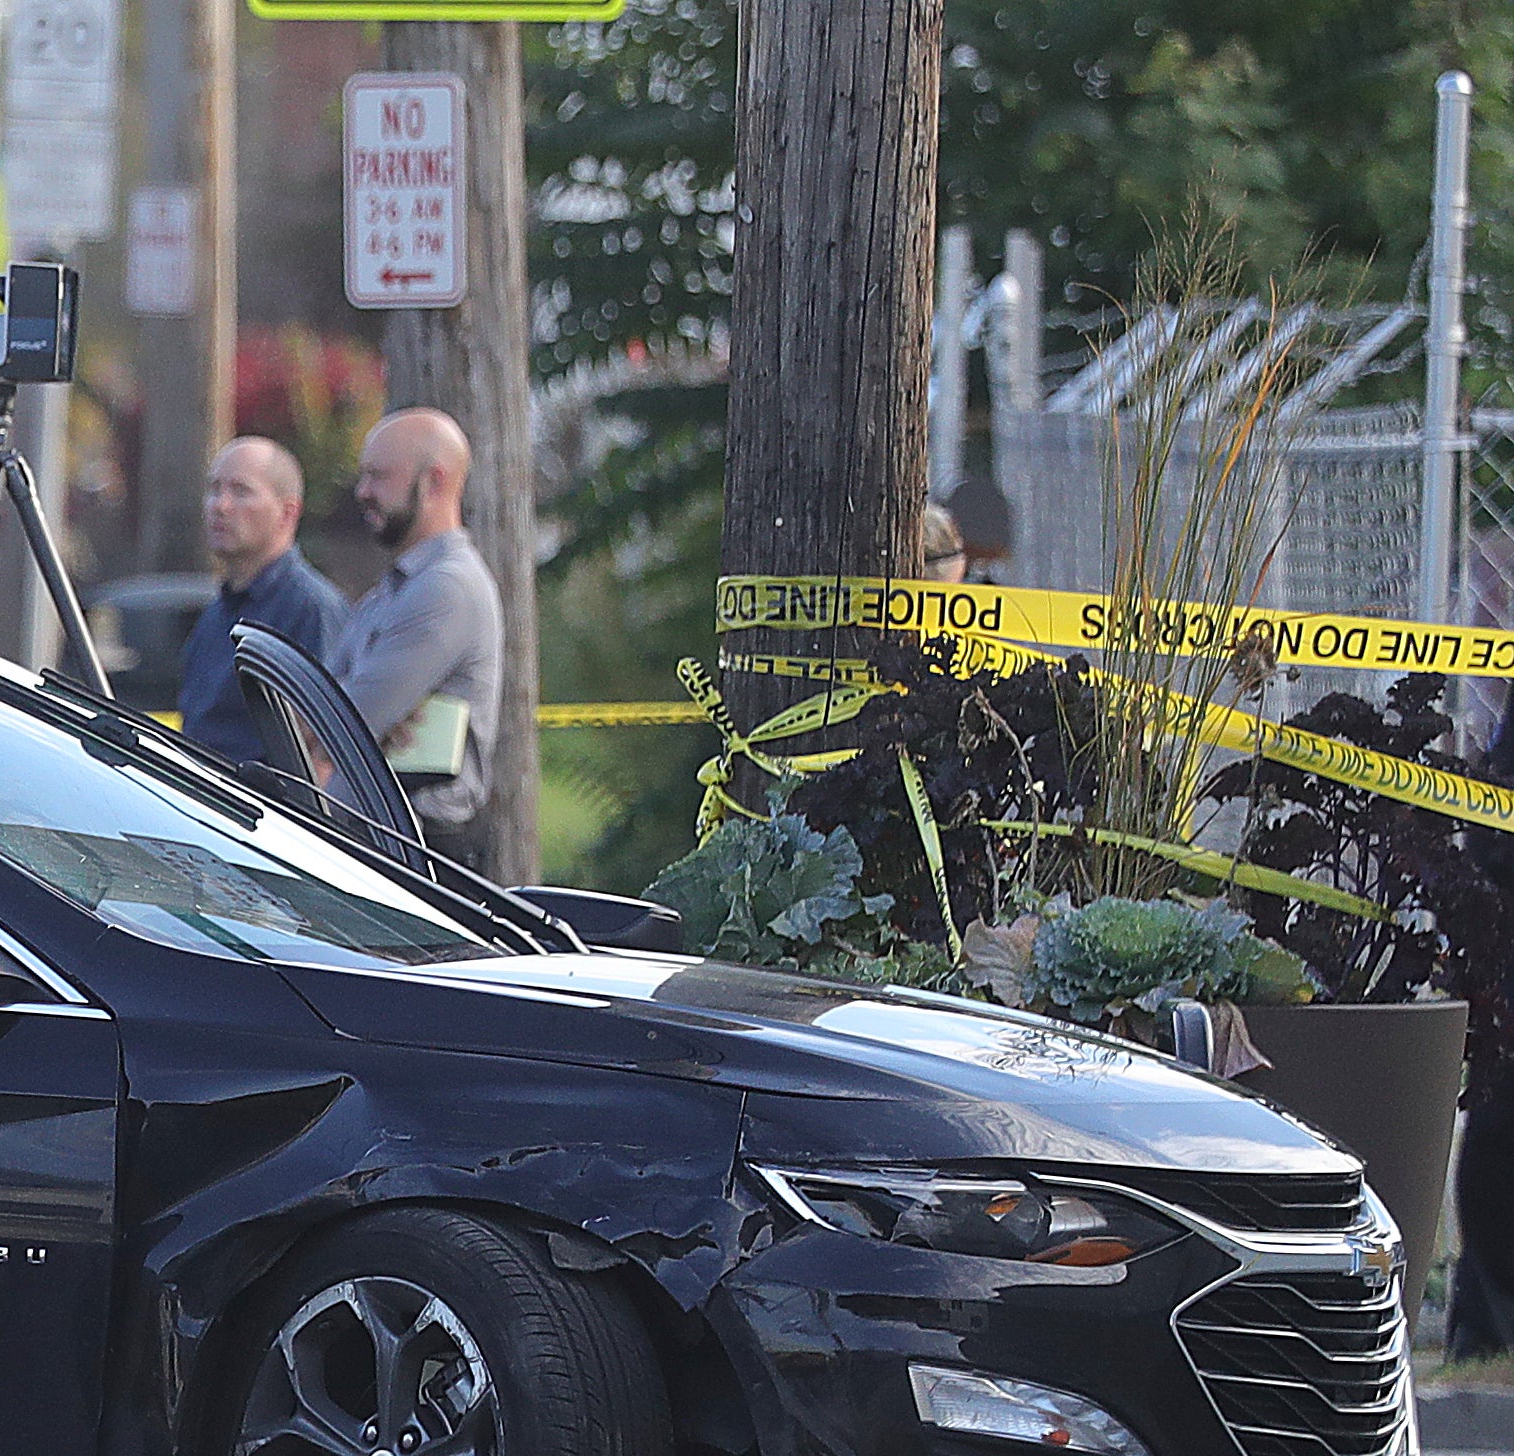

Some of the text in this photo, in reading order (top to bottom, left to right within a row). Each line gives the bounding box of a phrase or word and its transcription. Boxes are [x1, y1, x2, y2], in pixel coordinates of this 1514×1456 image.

[381, 99, 426, 139] NO
[353, 150, 455, 186] PARKING
[413, 230, 444, 256] PM
[764, 584, 851, 622] LINE
[861, 586, 1003, 632] POLICE
[1312, 624, 1369, 661] DO
[1375, 630, 1462, 669] LINE
